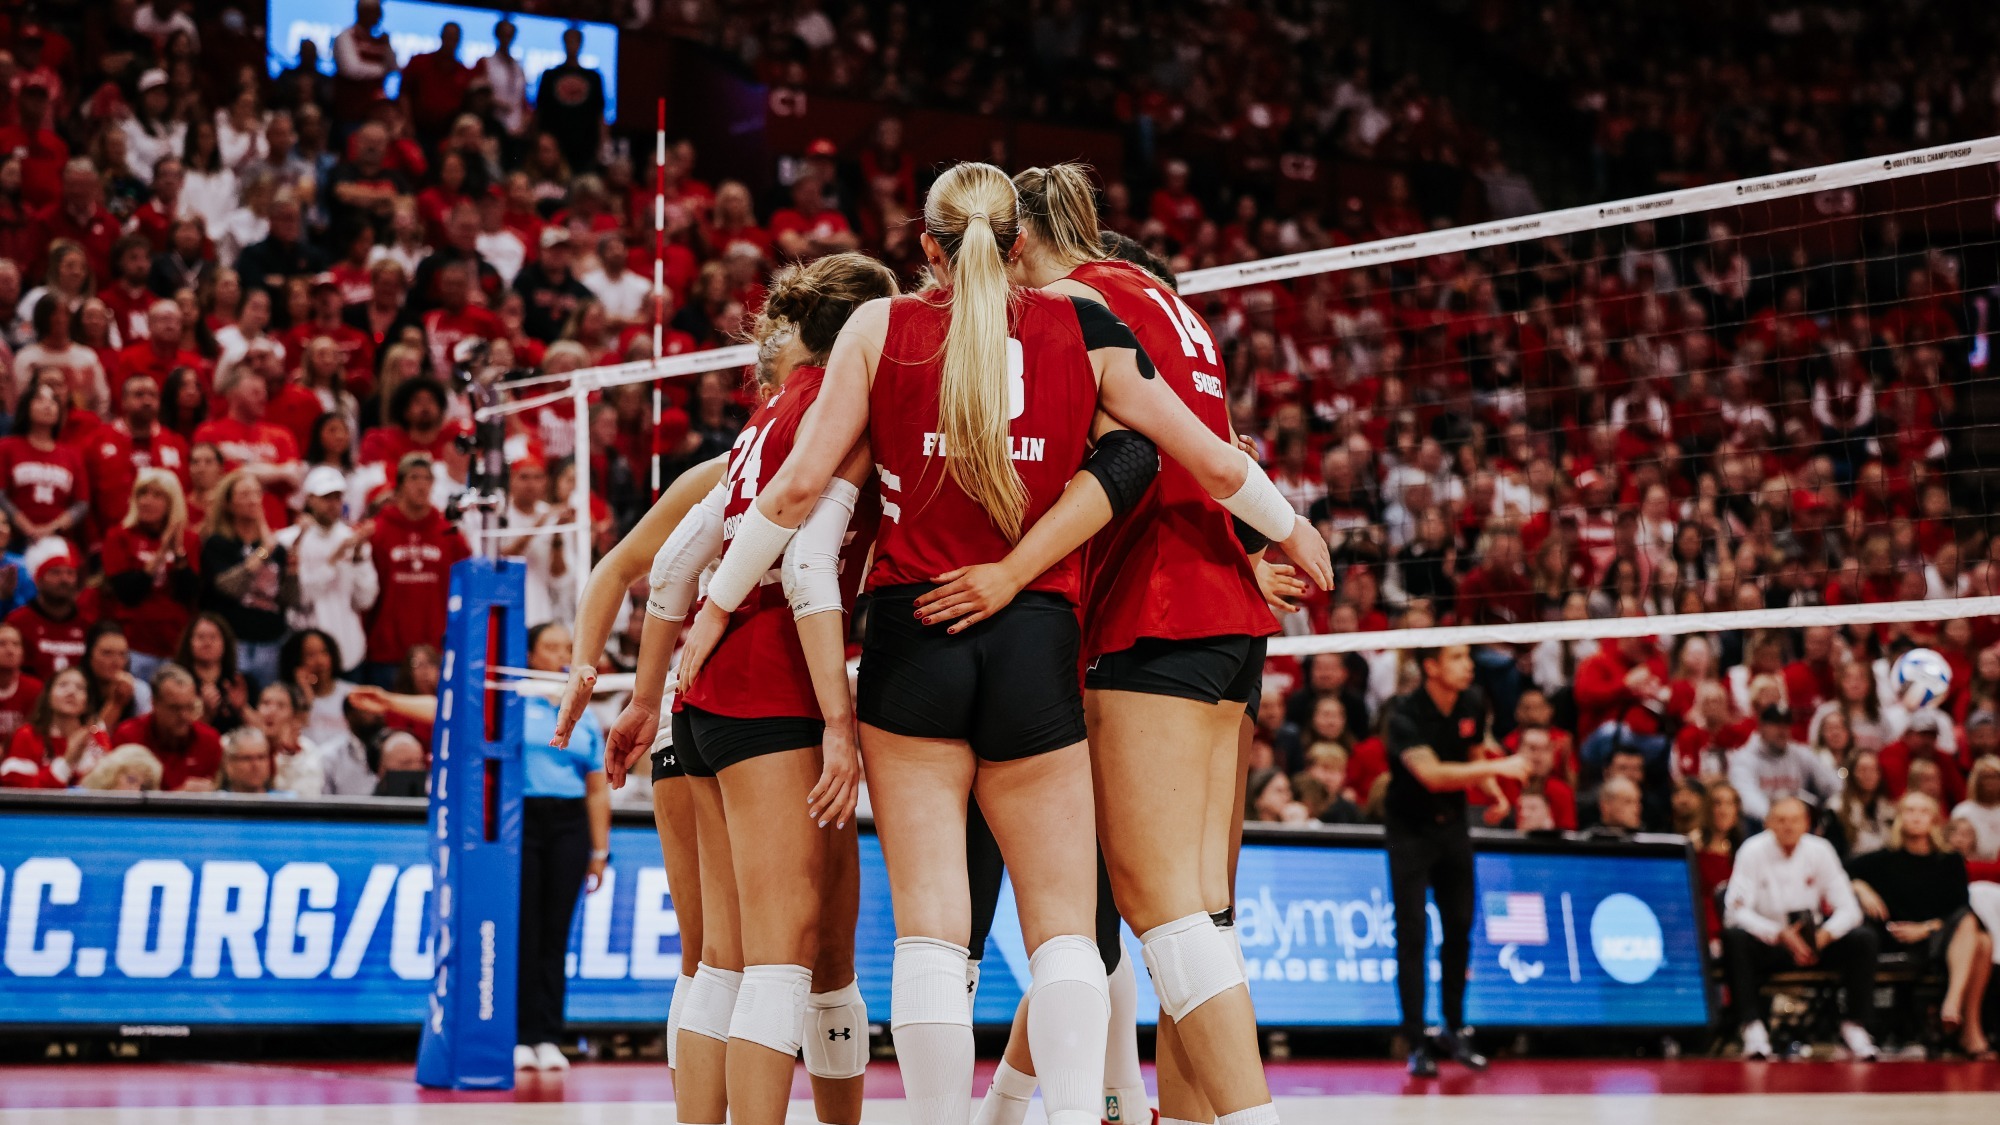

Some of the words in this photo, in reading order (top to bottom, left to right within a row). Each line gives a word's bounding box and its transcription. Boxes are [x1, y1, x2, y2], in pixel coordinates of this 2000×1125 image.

[1892, 155, 1926, 168] VOLLEYBALL
[1926, 147, 1972, 163] CHAMPIONSHIP
[1143, 288, 1217, 366] 14
[725, 418, 777, 507] 24
[922, 432, 1046, 462] FLIN
[0, 857, 434, 980] C.ORG/C
